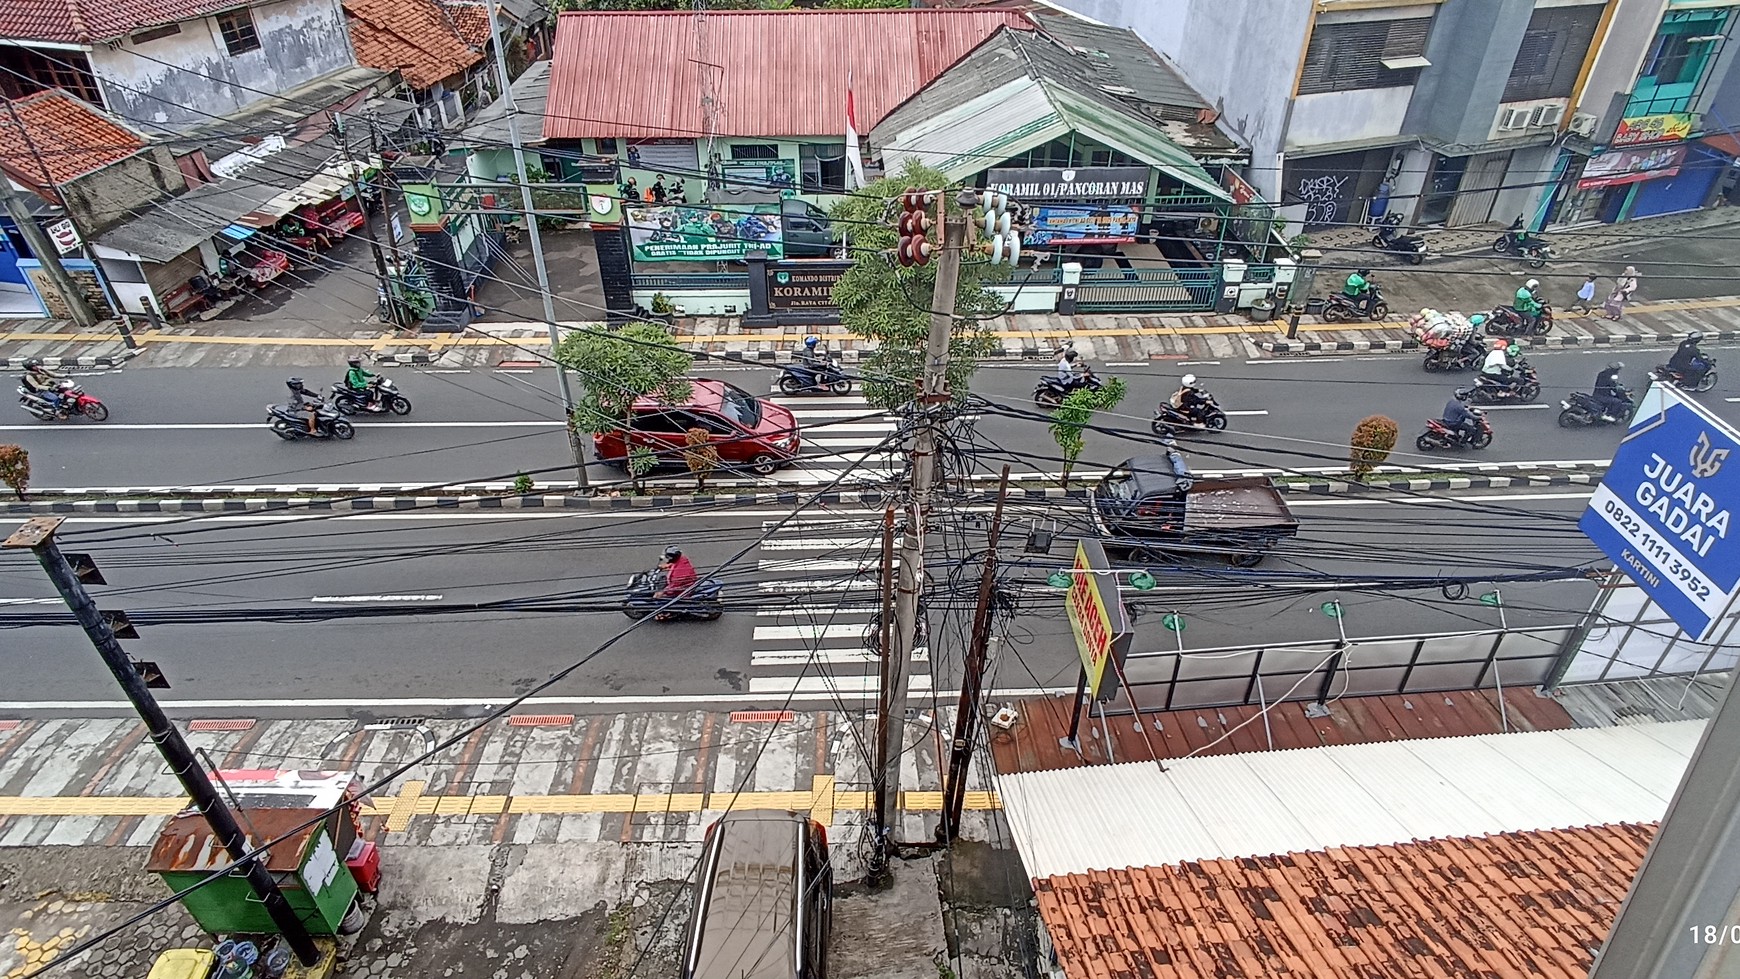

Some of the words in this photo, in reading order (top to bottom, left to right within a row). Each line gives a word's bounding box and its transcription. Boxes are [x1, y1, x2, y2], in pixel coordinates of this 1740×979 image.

[1043, 182, 1120, 198] 01/PANCORAN
[1120, 181, 1144, 195] MAS
[1635, 481, 1715, 558] GADAI
[1643, 452, 1730, 539] JUARA
[1604, 500, 1641, 538] 0822
[1641, 533, 1671, 565] 1111
[1669, 559, 1711, 602] 3952
[1620, 548, 1660, 588] KARTINI
